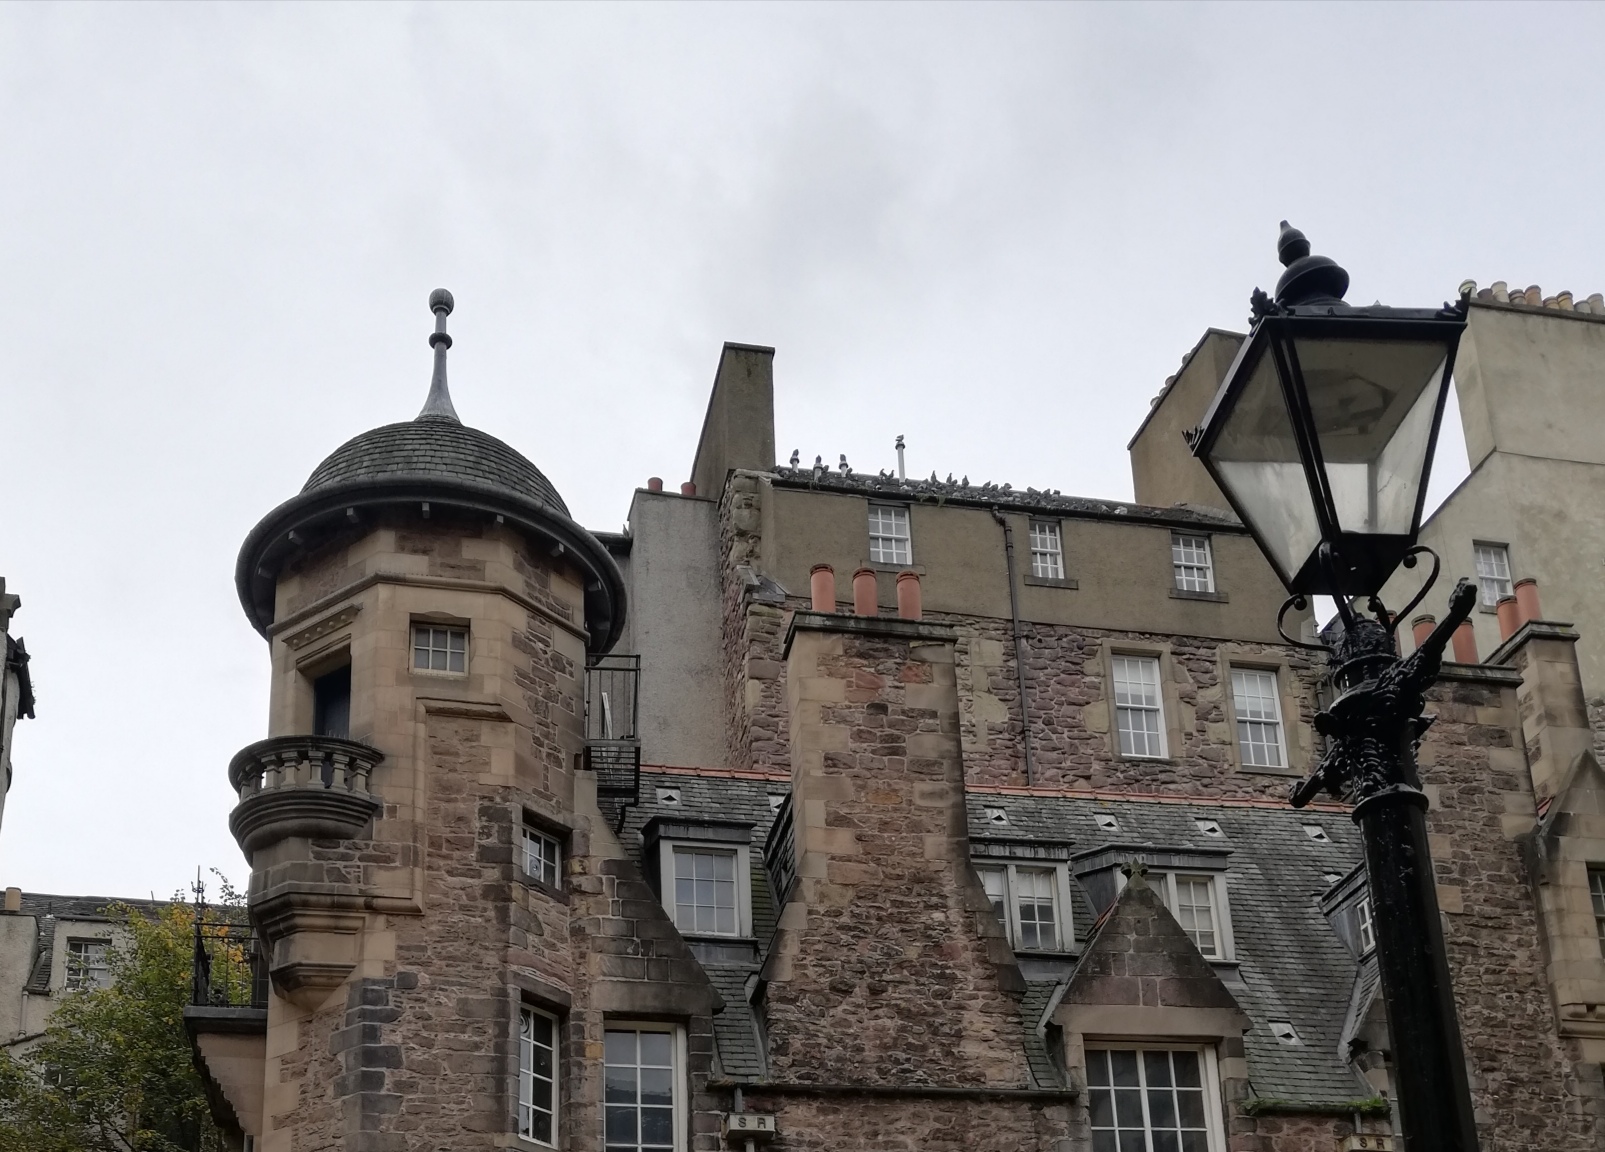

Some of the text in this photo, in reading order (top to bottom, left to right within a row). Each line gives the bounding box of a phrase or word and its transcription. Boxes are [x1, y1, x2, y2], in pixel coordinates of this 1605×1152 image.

[738, 1117, 766, 1129] S R
[1360, 1138, 1385, 1150] S R
